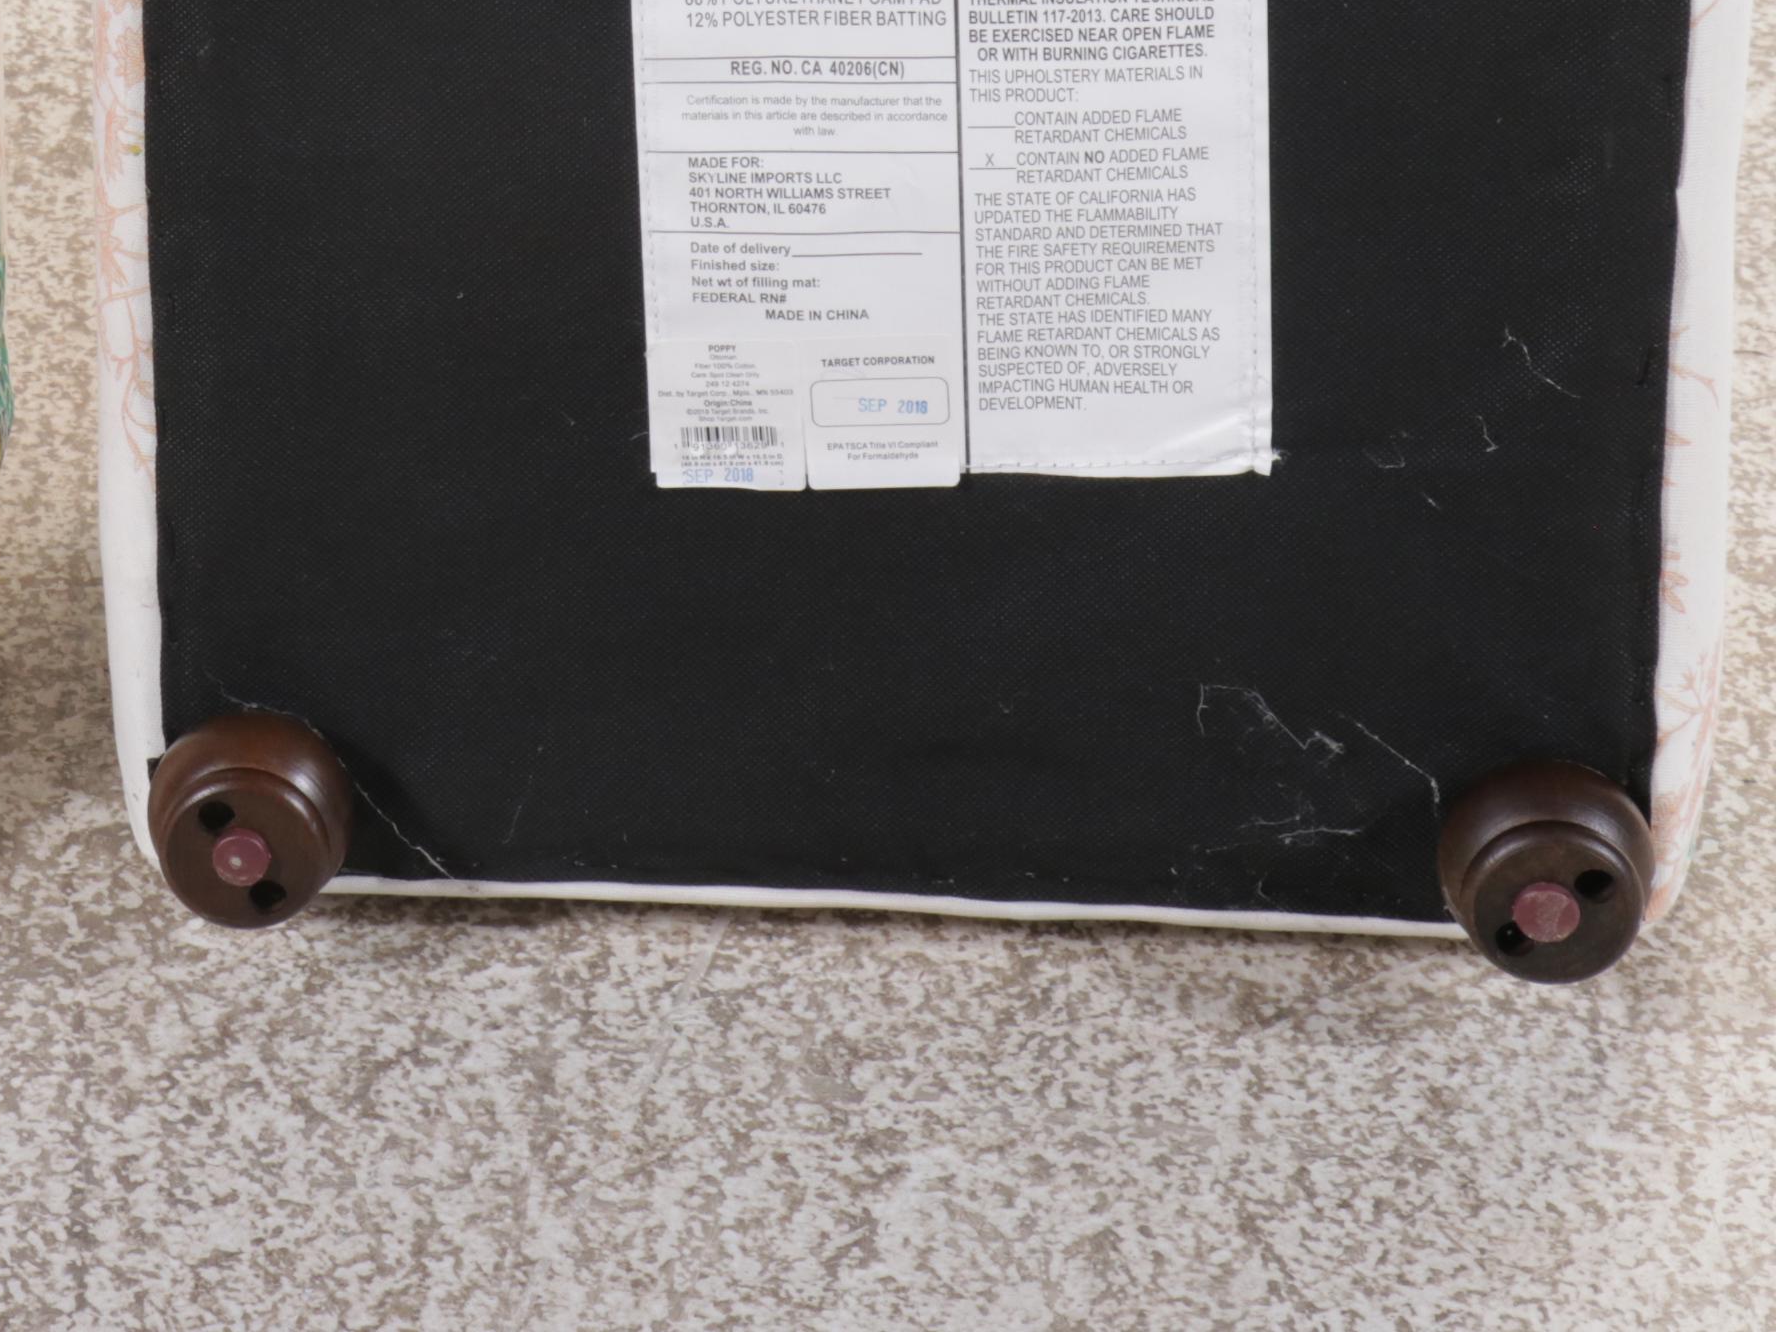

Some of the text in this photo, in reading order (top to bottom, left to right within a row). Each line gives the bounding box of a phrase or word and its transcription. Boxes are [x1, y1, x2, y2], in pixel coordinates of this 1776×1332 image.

[687, 10, 947, 28] 12% POLYESTER FIBER BATTING
[968, 6, 1214, 25] BULLETIN 117-2013. CARE SHOULD
[969, 24, 1214, 43] BE EXERCISED NEAR OPEN FLAME
[977, 43, 1207, 61] OR WITH BURNING CIGARETTES.
[731, 60, 904, 78] REG. NO. CA 40206(CN)
[985, 153, 995, 168] X
[1017, 146, 1209, 166] CONTAIN NO ADDED FLAME
[765, 309, 869, 321] MADE IN CHINA
[708, 344, 736, 353] POPPY
[821, 355, 935, 367] TARGET CORPORATION
[858, 398, 887, 413] SEP
[979, 396, 1087, 411] DEVELOPMENT.
[685, 467, 754, 484] SEP 2018
